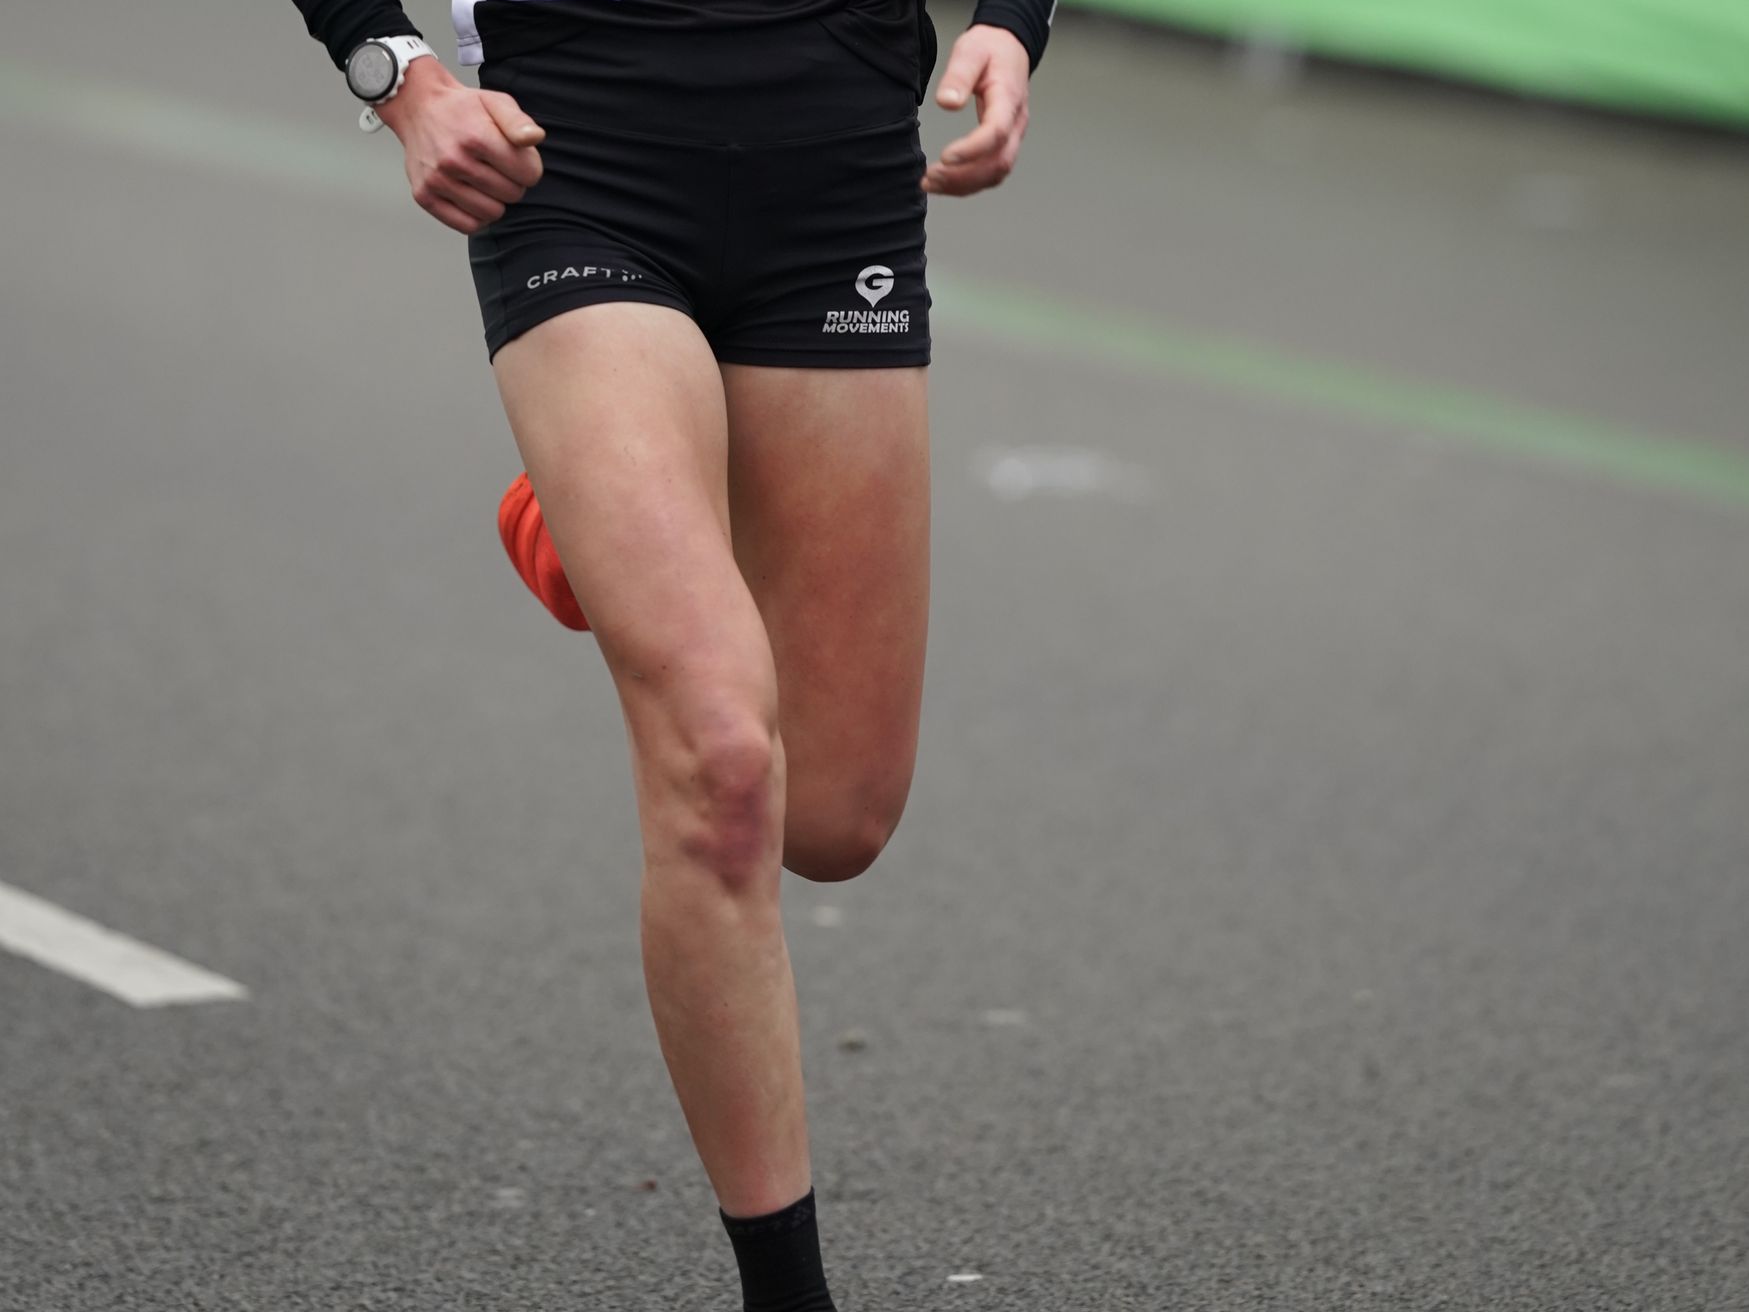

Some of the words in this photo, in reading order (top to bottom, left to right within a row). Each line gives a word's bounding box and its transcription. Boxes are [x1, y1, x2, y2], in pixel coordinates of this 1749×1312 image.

[526, 266, 612, 289] CRAFT
[825, 309, 910, 323] RUNNING
[822, 322, 909, 333] MOVEMENTS
